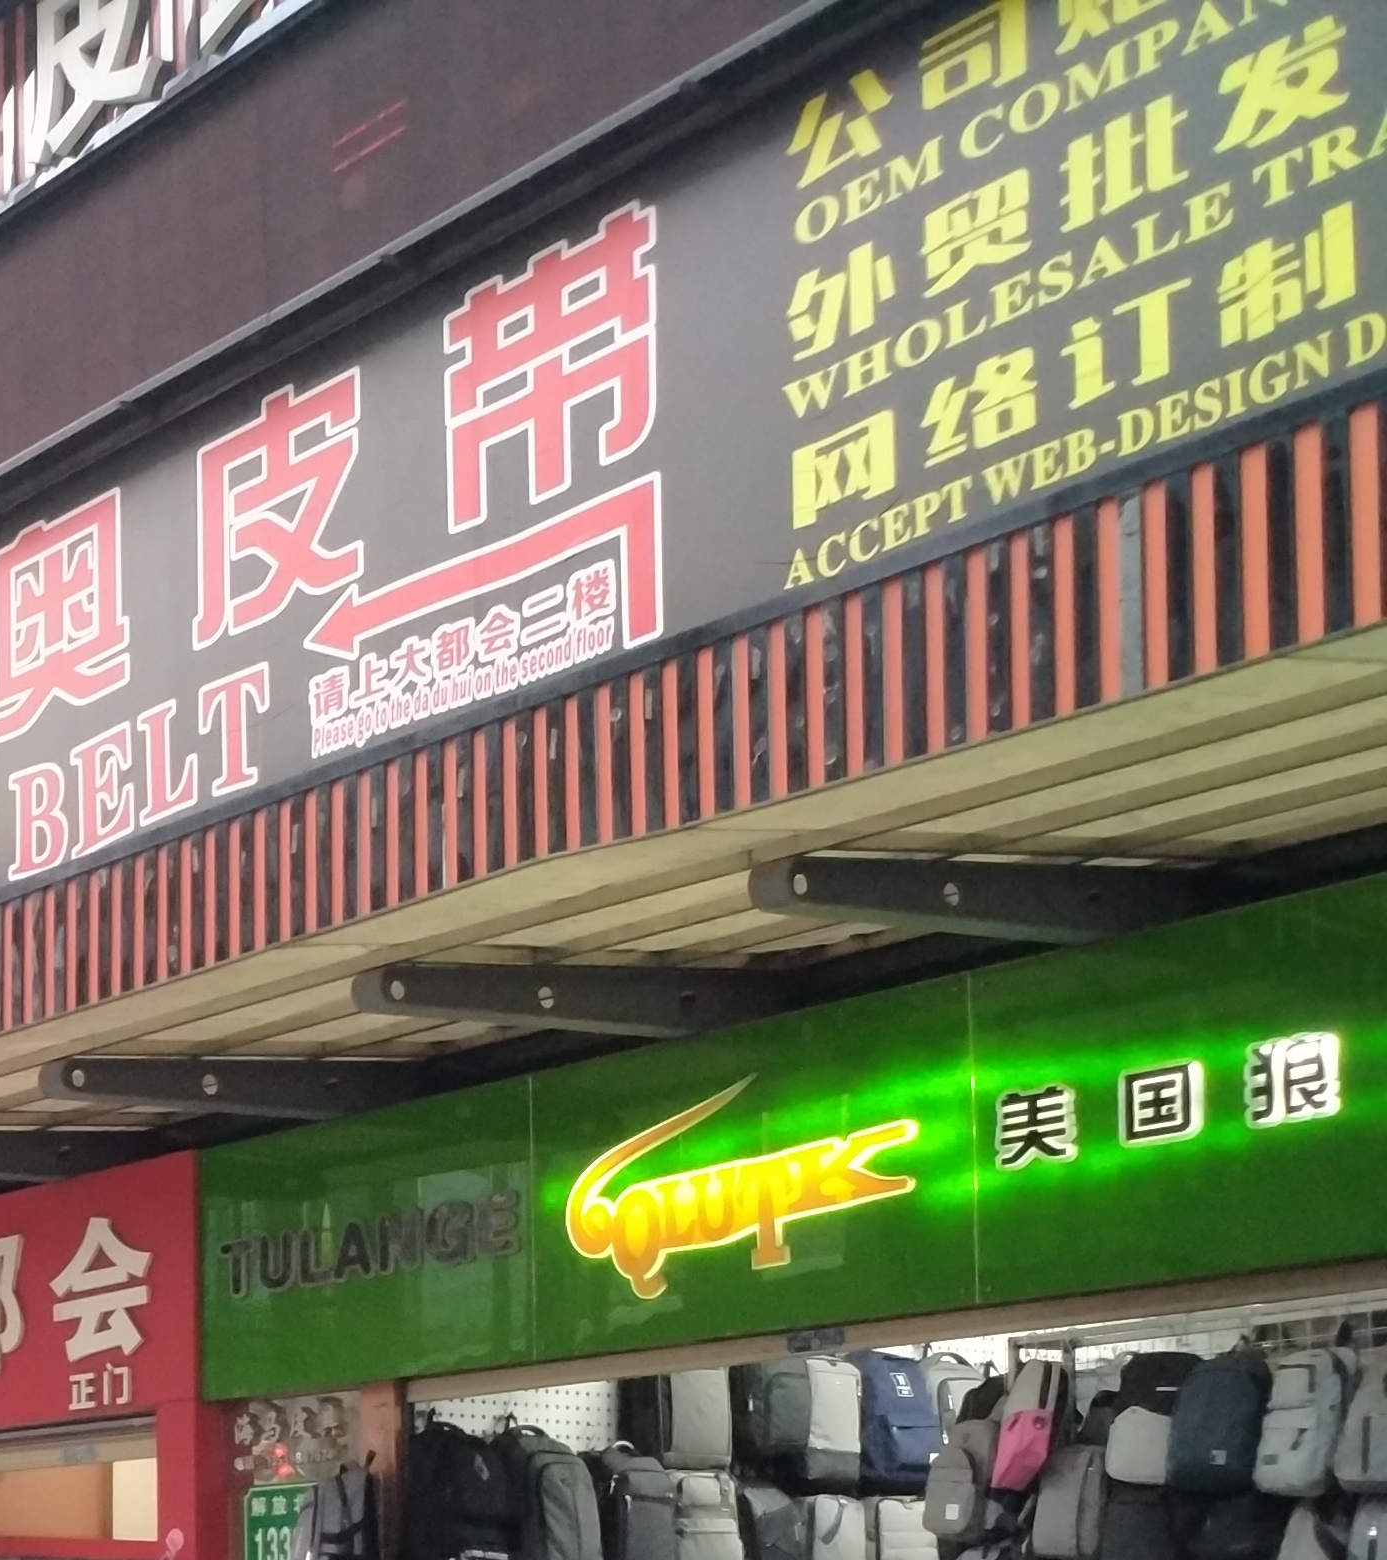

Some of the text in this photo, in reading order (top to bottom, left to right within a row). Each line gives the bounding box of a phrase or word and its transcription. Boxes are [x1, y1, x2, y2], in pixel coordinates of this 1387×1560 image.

[785, 14, 1350, 362] 外贸批发
[793, 136, 943, 245] OEM
[782, 180, 1234, 420] WHOLESALE
[790, 200, 1356, 530] 网络订制
[783, 474, 973, 590] ACCEPT
[982, 330, 1333, 506] WEB-DESIGN
[310, 560, 615, 722] 请上大都会二楼
[313, 620, 613, 752] Please go to the da du hui on the second floor
[8, 662, 269, 881] BELT
[996, 1032, 1340, 1171] 美国狼
[68, 1362, 132, 1411] 正门
